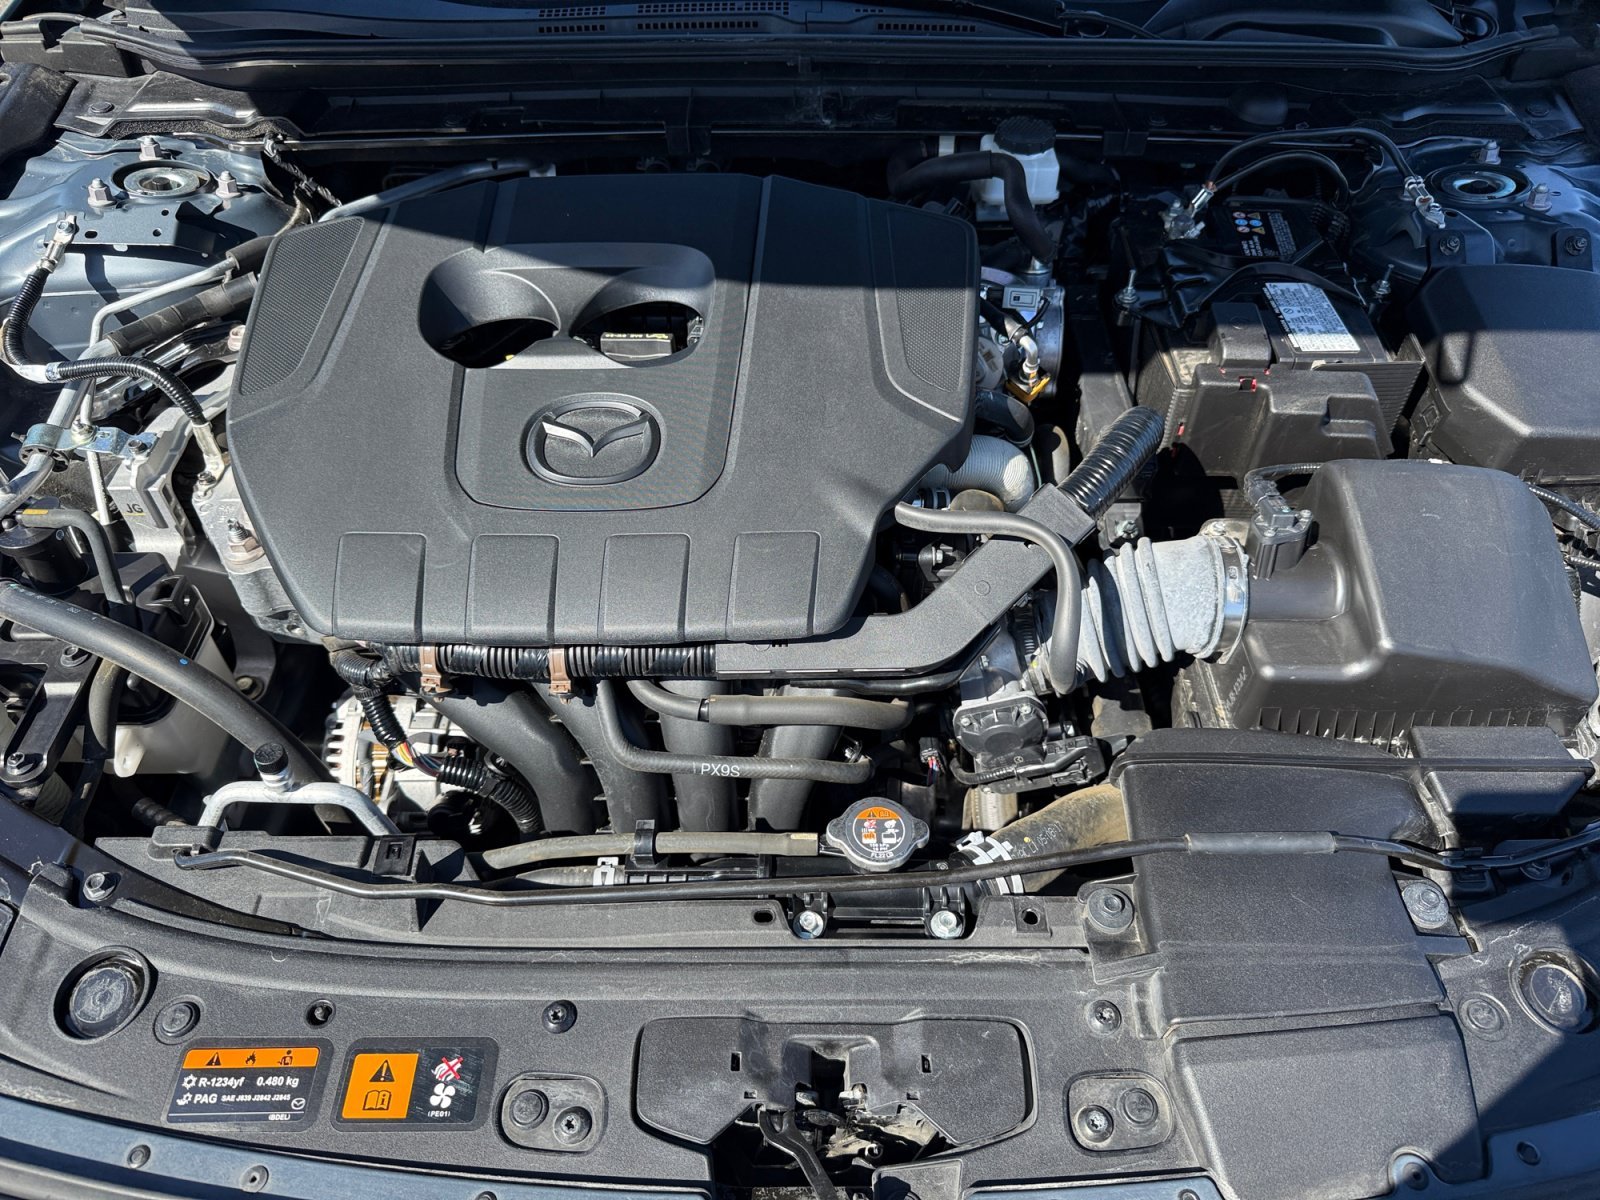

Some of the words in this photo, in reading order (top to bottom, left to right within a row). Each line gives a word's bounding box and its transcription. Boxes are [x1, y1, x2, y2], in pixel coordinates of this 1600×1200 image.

[126, 503, 143, 513] JG
[701, 762, 740, 777] PX9S
[198, 1076, 245, 1089] R-1234yf
[256, 1076, 284, 1087] 0.480
[285, 1076, 300, 1088] kg
[193, 1093, 218, 1104] PAG
[221, 1094, 235, 1102] SAE
